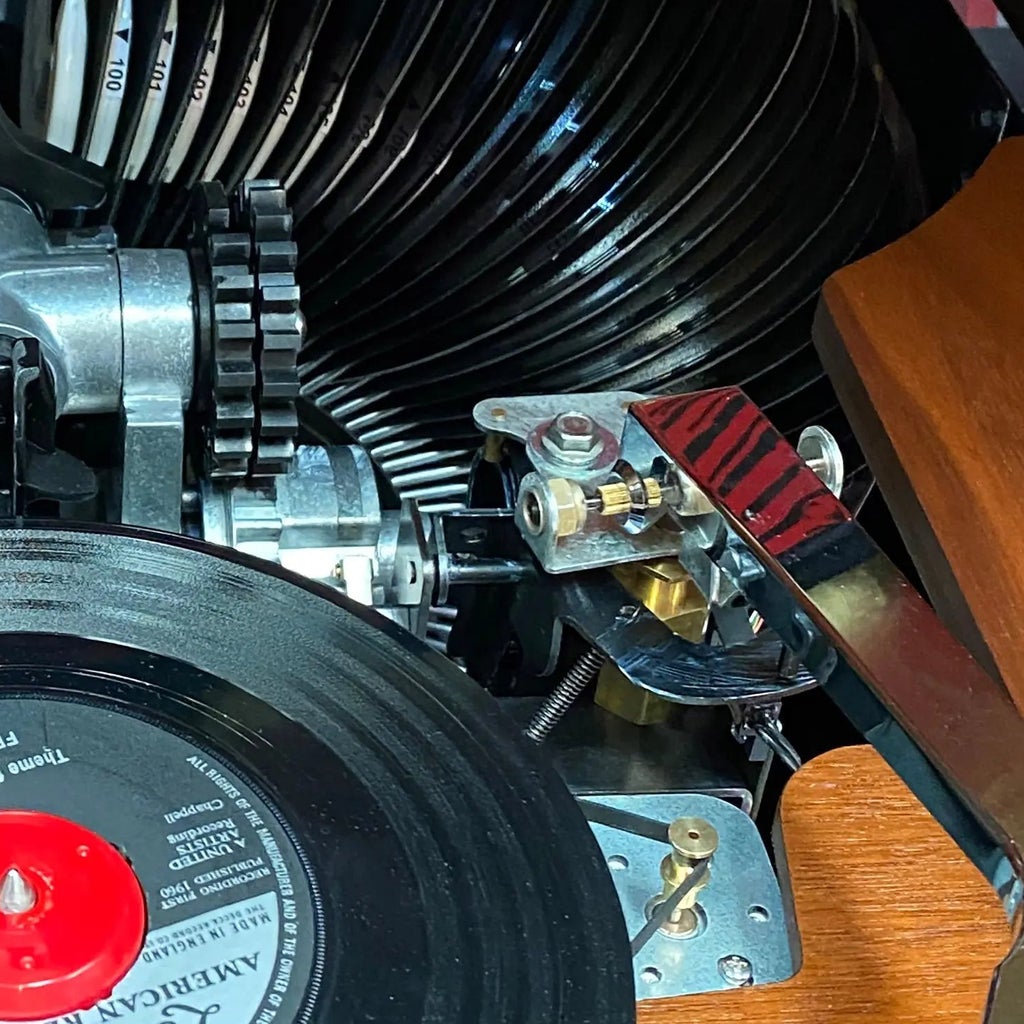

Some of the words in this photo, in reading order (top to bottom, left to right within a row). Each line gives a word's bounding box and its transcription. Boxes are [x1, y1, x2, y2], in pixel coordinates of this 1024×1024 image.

[106, 58, 123, 92] 100
[149, 59, 167, 92] 101
[7, 748, 70, 775] Theme
[186, 756, 208, 773] ALL
[206, 768, 240, 799] RIGHTS
[163, 798, 224, 824] Chappell
[235, 798, 251, 809] OF
[244, 809, 264, 827] THE
[166, 817, 236, 845] Recording
[176, 828, 239, 856] ARTISTS
[233, 837, 246, 849] A
[168, 843, 233, 871] UNITED
[256, 828, 294, 896] MANUFACTURER
[193, 856, 264, 885] PUBLISHED
[159, 880, 191, 898] 1960
[199, 867, 271, 896] RECORDING
[160, 890, 197, 911] FIRST
[245, 904, 265, 914] THE
[282, 898, 297, 919] AND
[212, 910, 242, 925] DECCA
[229, 912, 272, 933] MADE
[283, 921, 297, 935] OF
[172, 922, 209, 939] RECORD
[209, 926, 226, 940] IN
[142, 934, 207, 963] ENGLAND
[281, 937, 297, 956] THE
[273, 958, 294, 993] OWNER
[94, 951, 261, 1023] AMERICAN
[268, 993, 283, 1007] OF
